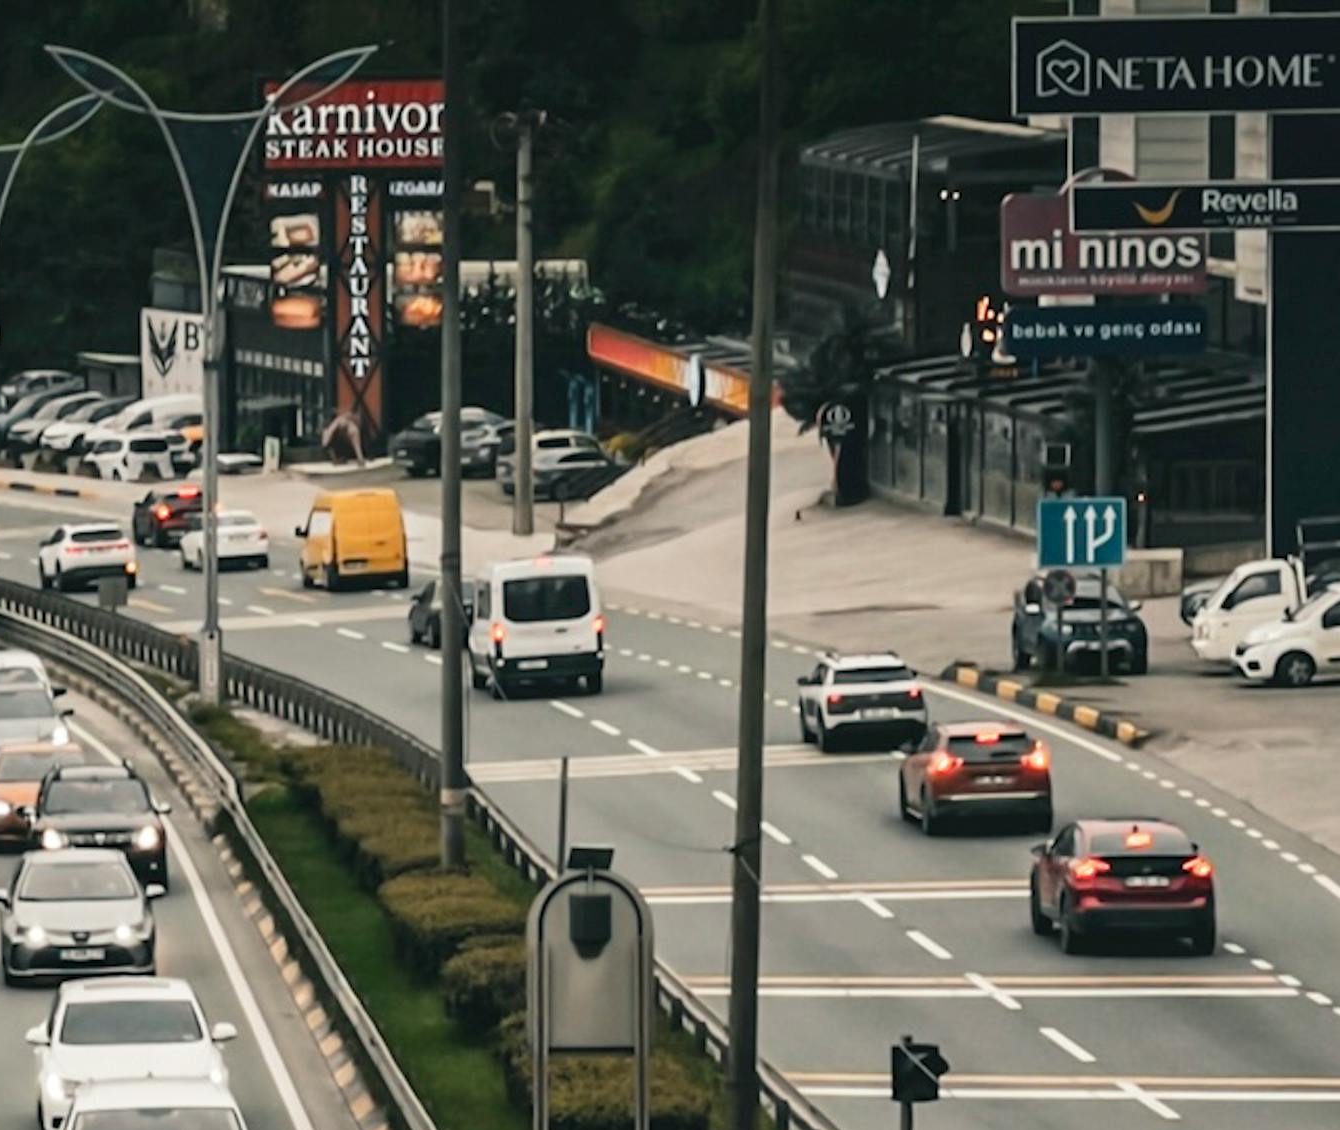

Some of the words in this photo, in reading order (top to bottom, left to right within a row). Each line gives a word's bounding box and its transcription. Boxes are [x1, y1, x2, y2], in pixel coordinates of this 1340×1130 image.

[1095, 56, 1197, 90] NETA
[1204, 54, 1324, 88] HOME
[265, 138, 349, 158] STEAK
[357, 138, 445, 158] HOUSE
[267, 182, 323, 198] KASAP
[1201, 188, 1298, 212] Revella
[1011, 229, 1063, 270] mi
[1079, 232, 1202, 269] ninos
[349, 174, 370, 378] RESTAURANT
[1011, 322, 1068, 339] bebek
[1073, 324, 1095, 339] ve
[1099, 322, 1145, 341] genç
